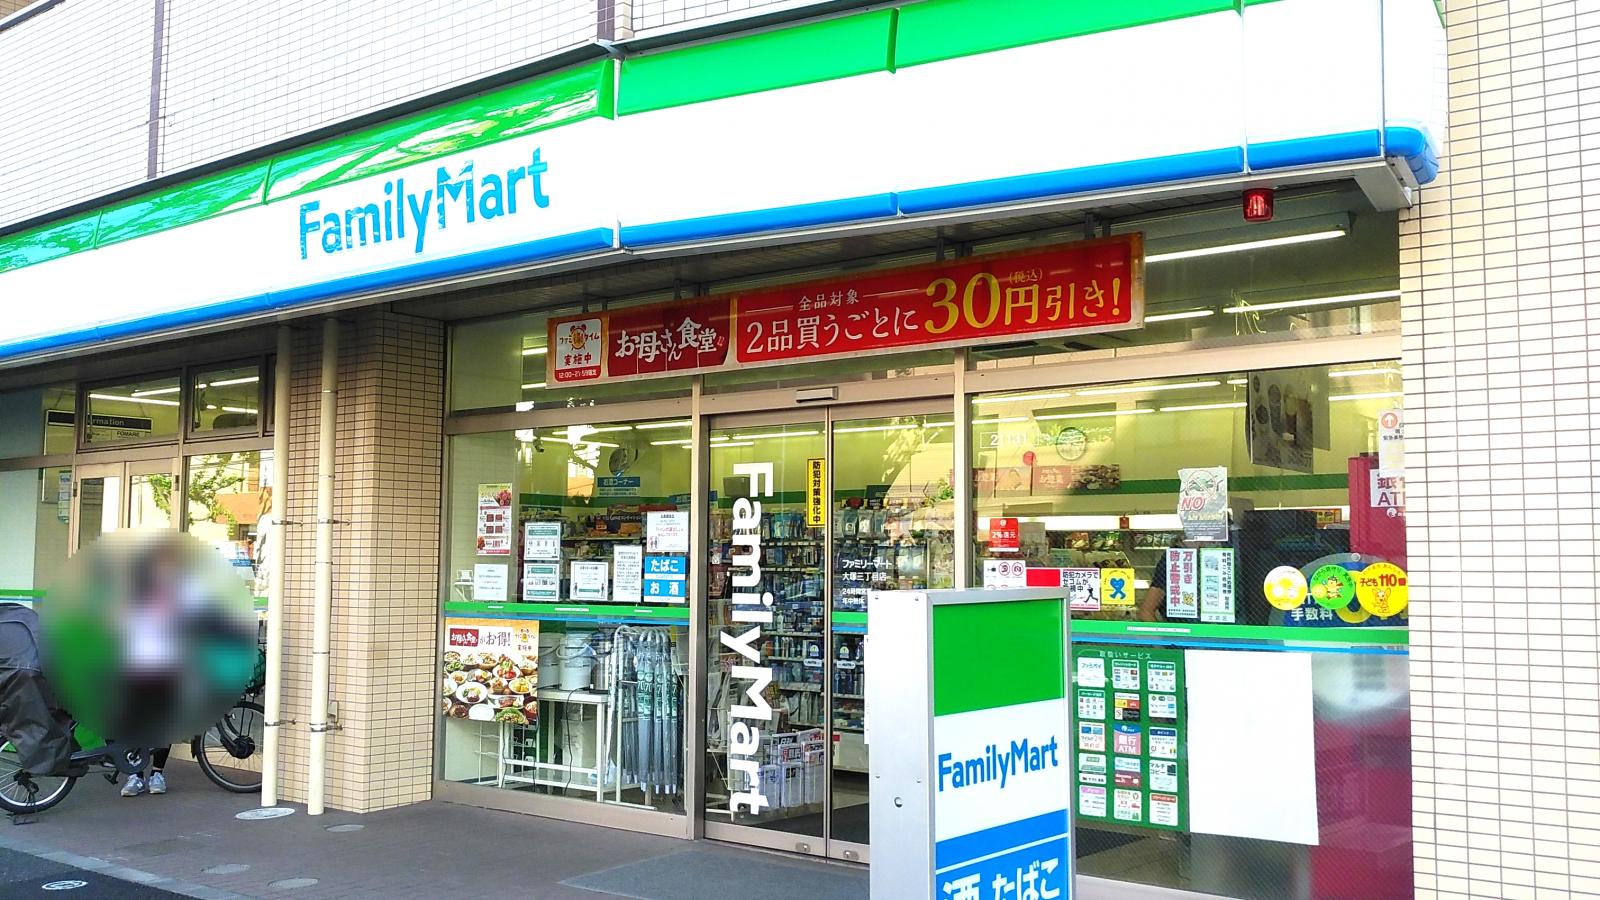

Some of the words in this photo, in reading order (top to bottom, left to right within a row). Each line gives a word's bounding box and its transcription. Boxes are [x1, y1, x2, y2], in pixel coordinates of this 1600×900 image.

[300, 147, 549, 260] FamilyMart
[799, 289, 859, 311] 全品対象
[615, 316, 717, 362] お母さん食堂
[564, 352, 592, 366] 実施中
[812, 461, 821, 524] 防犯対策強化中
[1180, 496, 1205, 511] NO
[650, 559, 679, 572] たばこ
[842, 559, 893, 570] ファミリーマート
[1182, 551, 1193, 584] 万引き
[649, 581, 679, 596] お酒
[1169, 551, 1181, 607] 防止警戒中
[1291, 607, 1333, 621] 手数料
[720, 462, 774, 816] FamilyMart
[938, 735, 1059, 793] FamilyMart
